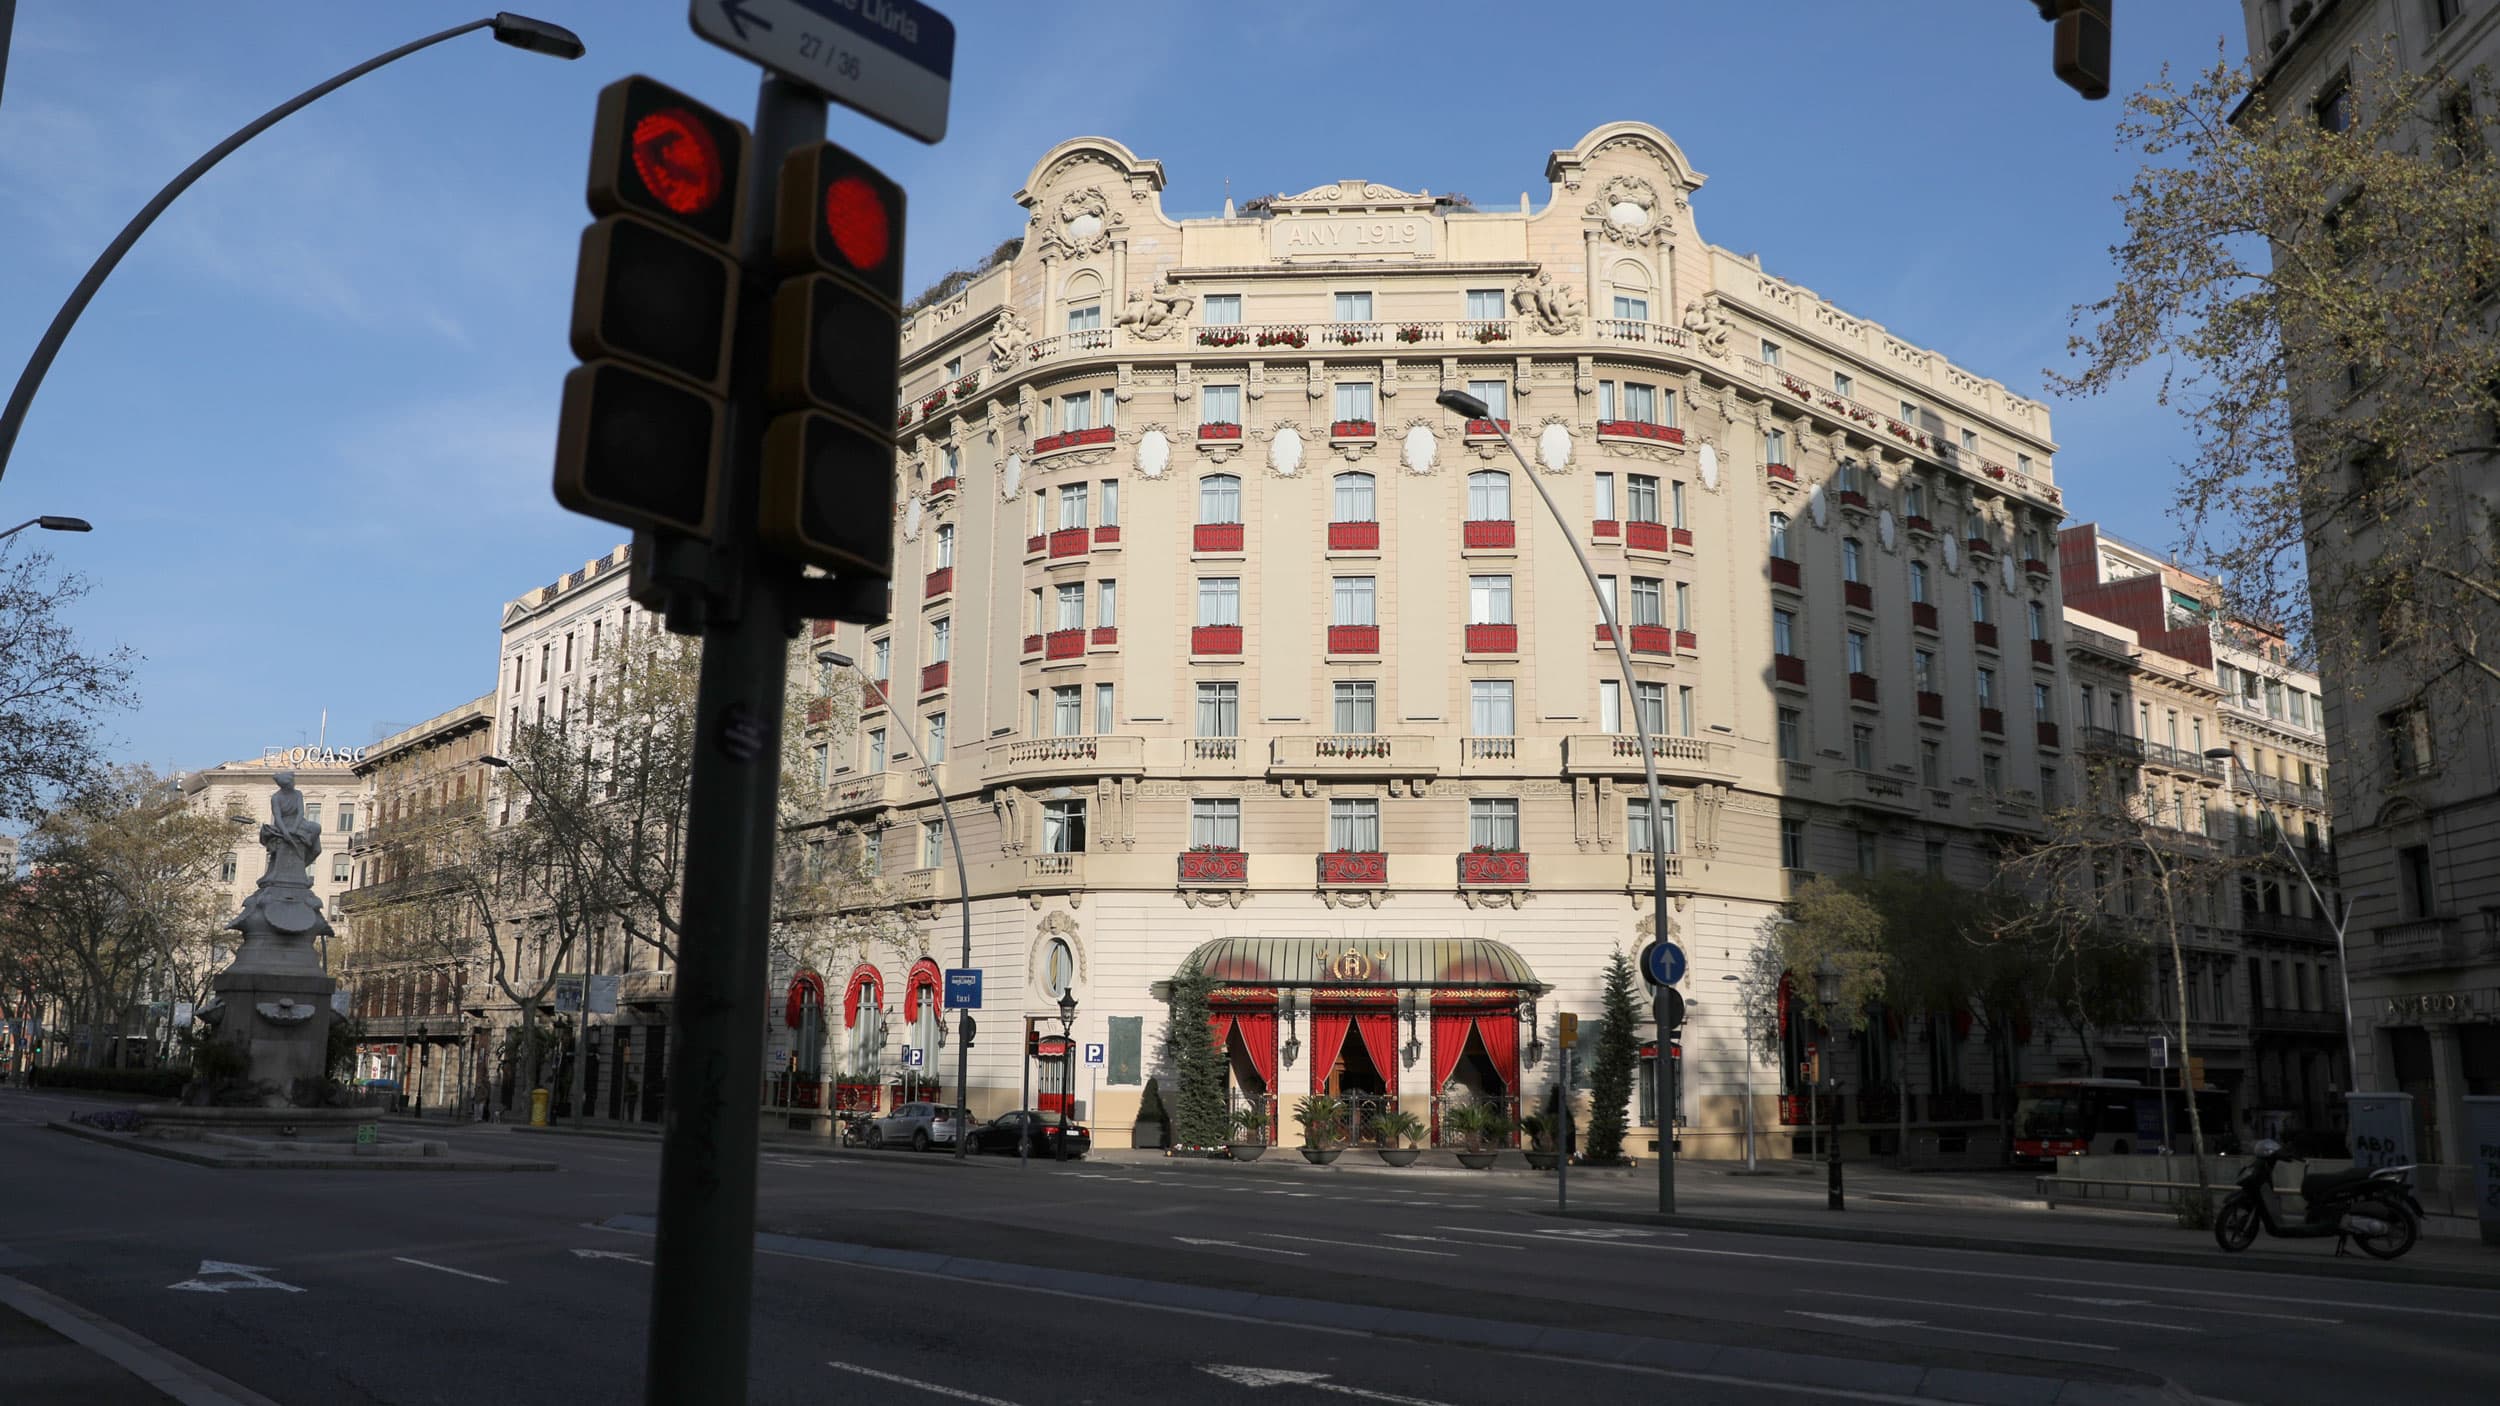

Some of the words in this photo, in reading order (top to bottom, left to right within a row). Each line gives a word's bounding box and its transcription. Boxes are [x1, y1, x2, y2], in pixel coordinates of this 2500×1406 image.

[799, 31, 823, 60] 27
[838, 51, 861, 82] 36
[1288, 223, 1344, 246] ANY
[1356, 223, 1416, 245] 1919
[956, 994, 970, 1003] taxi
[911, 1050, 921, 1065] P
[1088, 1045, 1101, 1062] P
